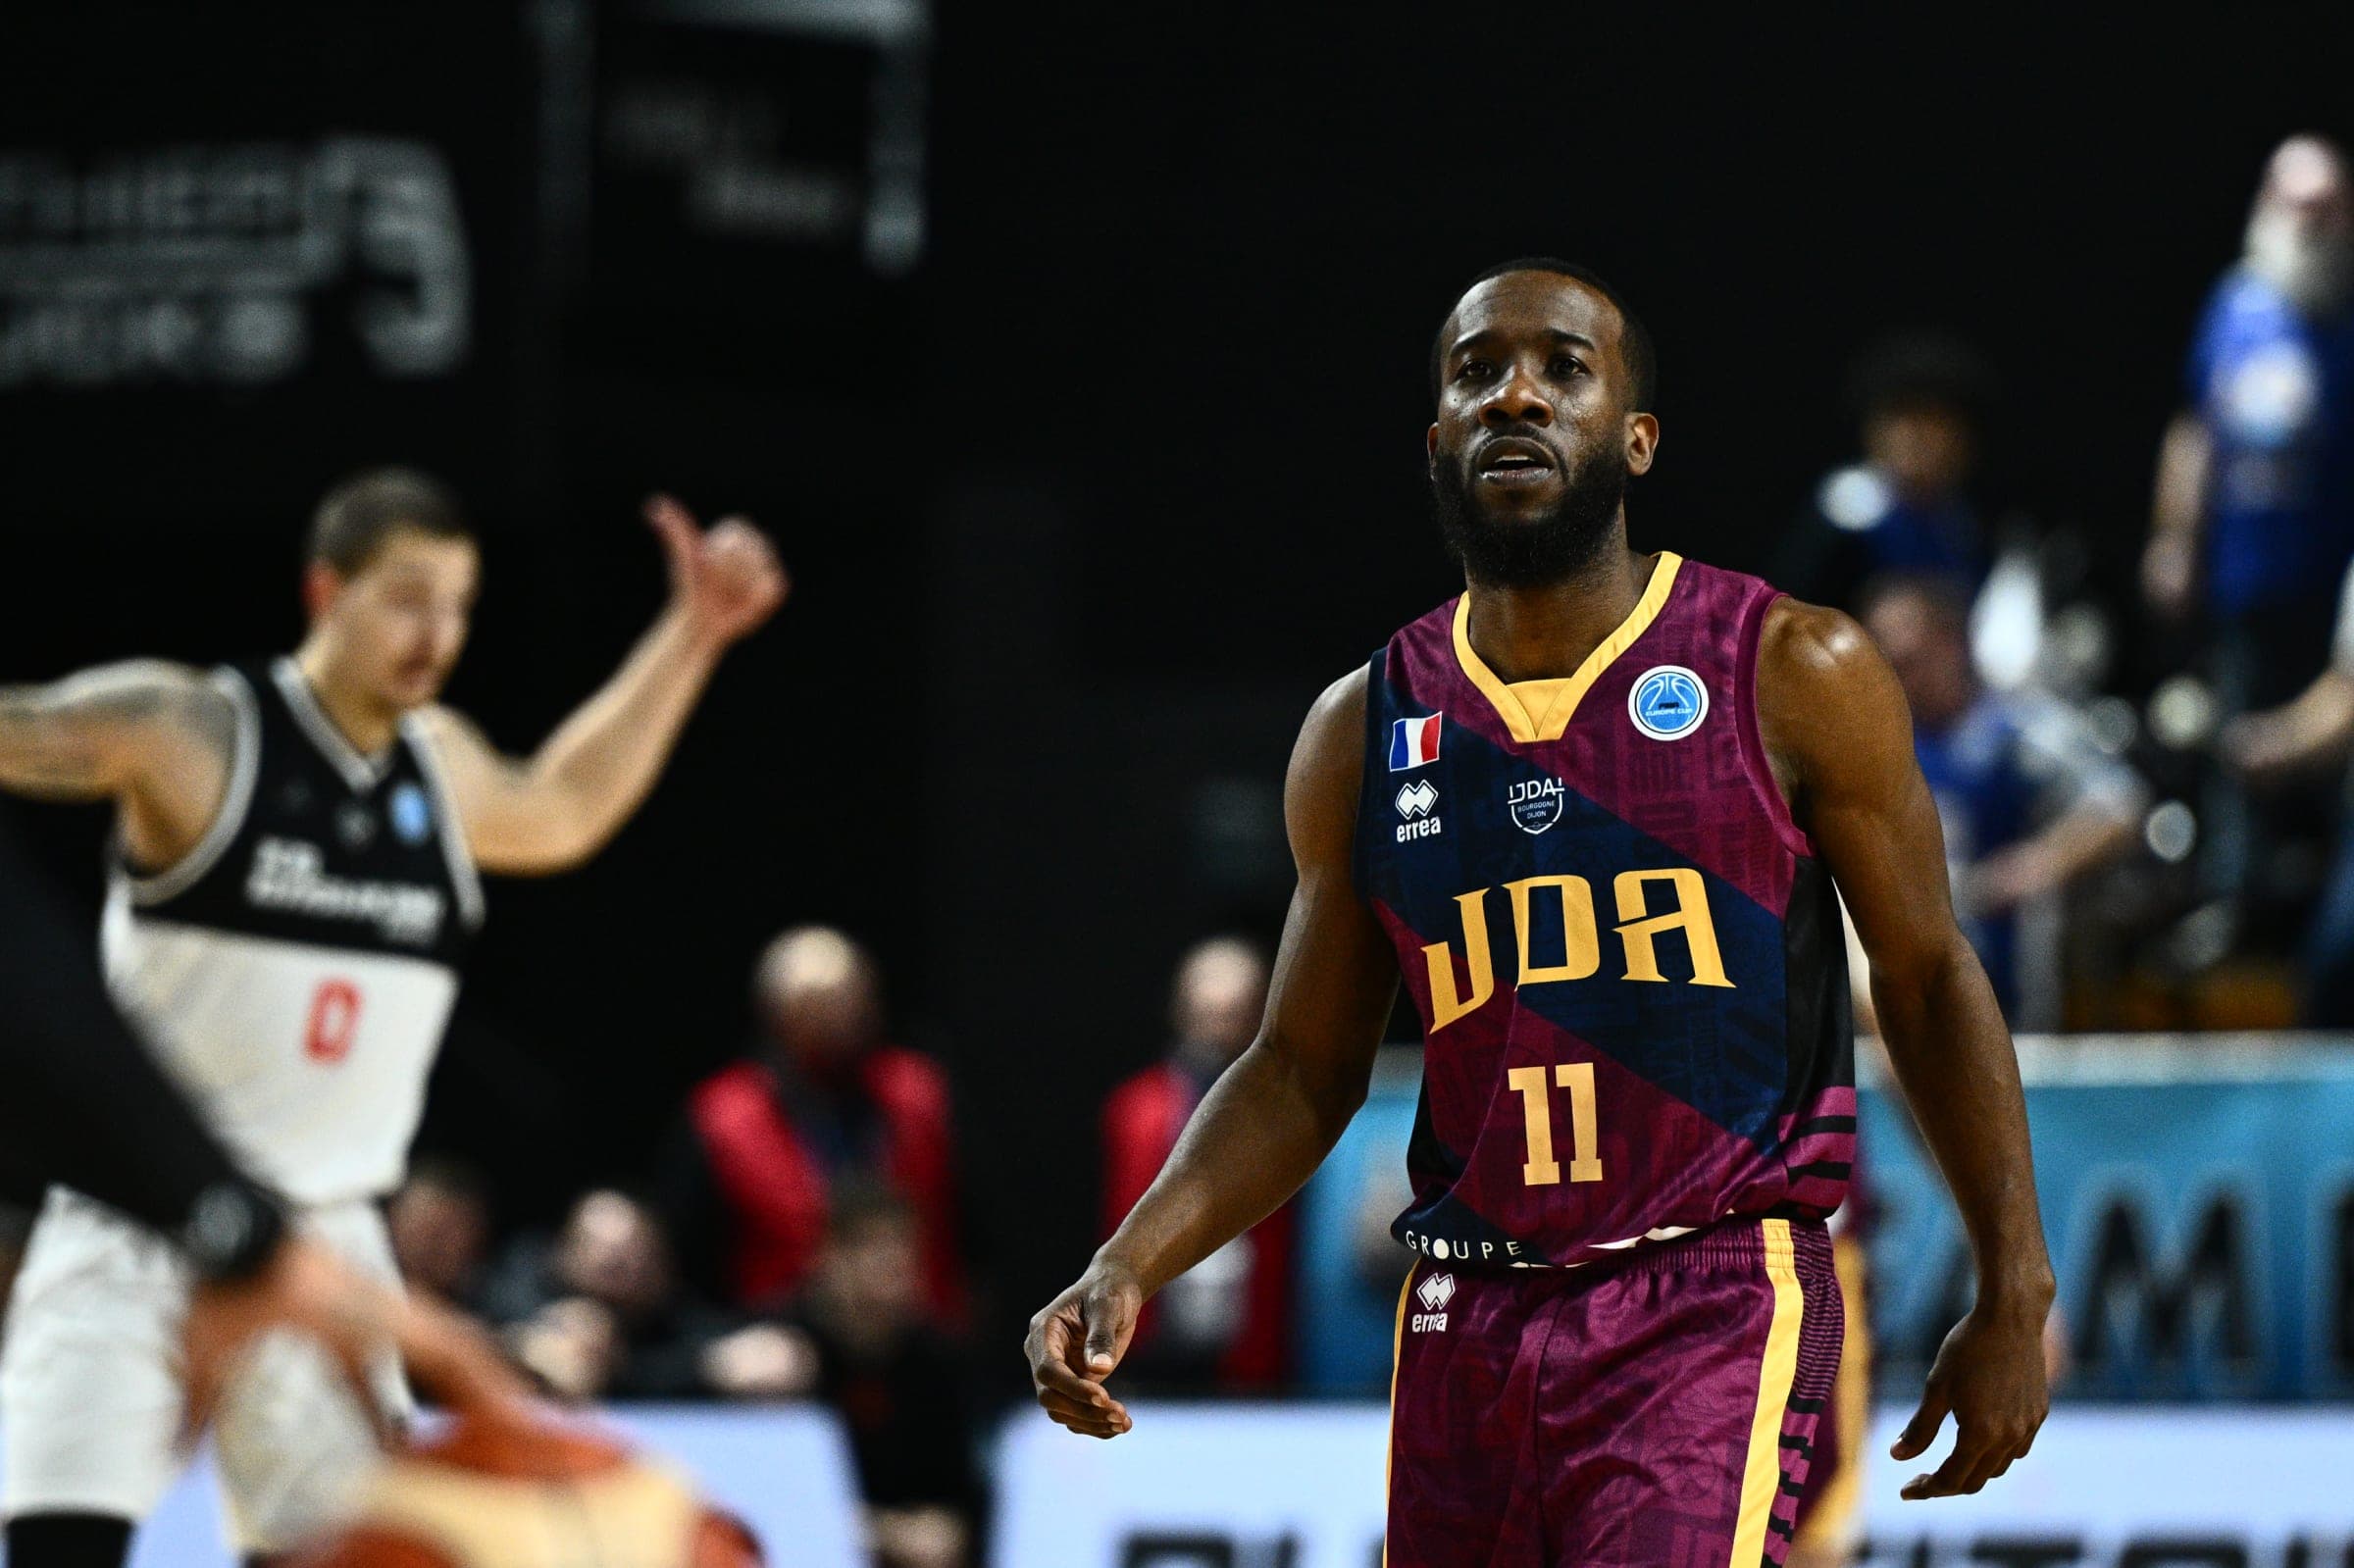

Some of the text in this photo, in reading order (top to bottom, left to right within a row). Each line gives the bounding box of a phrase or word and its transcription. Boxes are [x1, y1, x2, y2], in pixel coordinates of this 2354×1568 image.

[1516, 800, 1556, 814] BOURGOGNE
[1526, 810, 1547, 820] DIJON
[1397, 816, 1442, 842] errea
[1420, 868, 1737, 1035] JDA
[300, 977, 365, 1066] 0
[1508, 1062, 1604, 1186] 11
[1406, 1230, 1522, 1260] GROUPE
